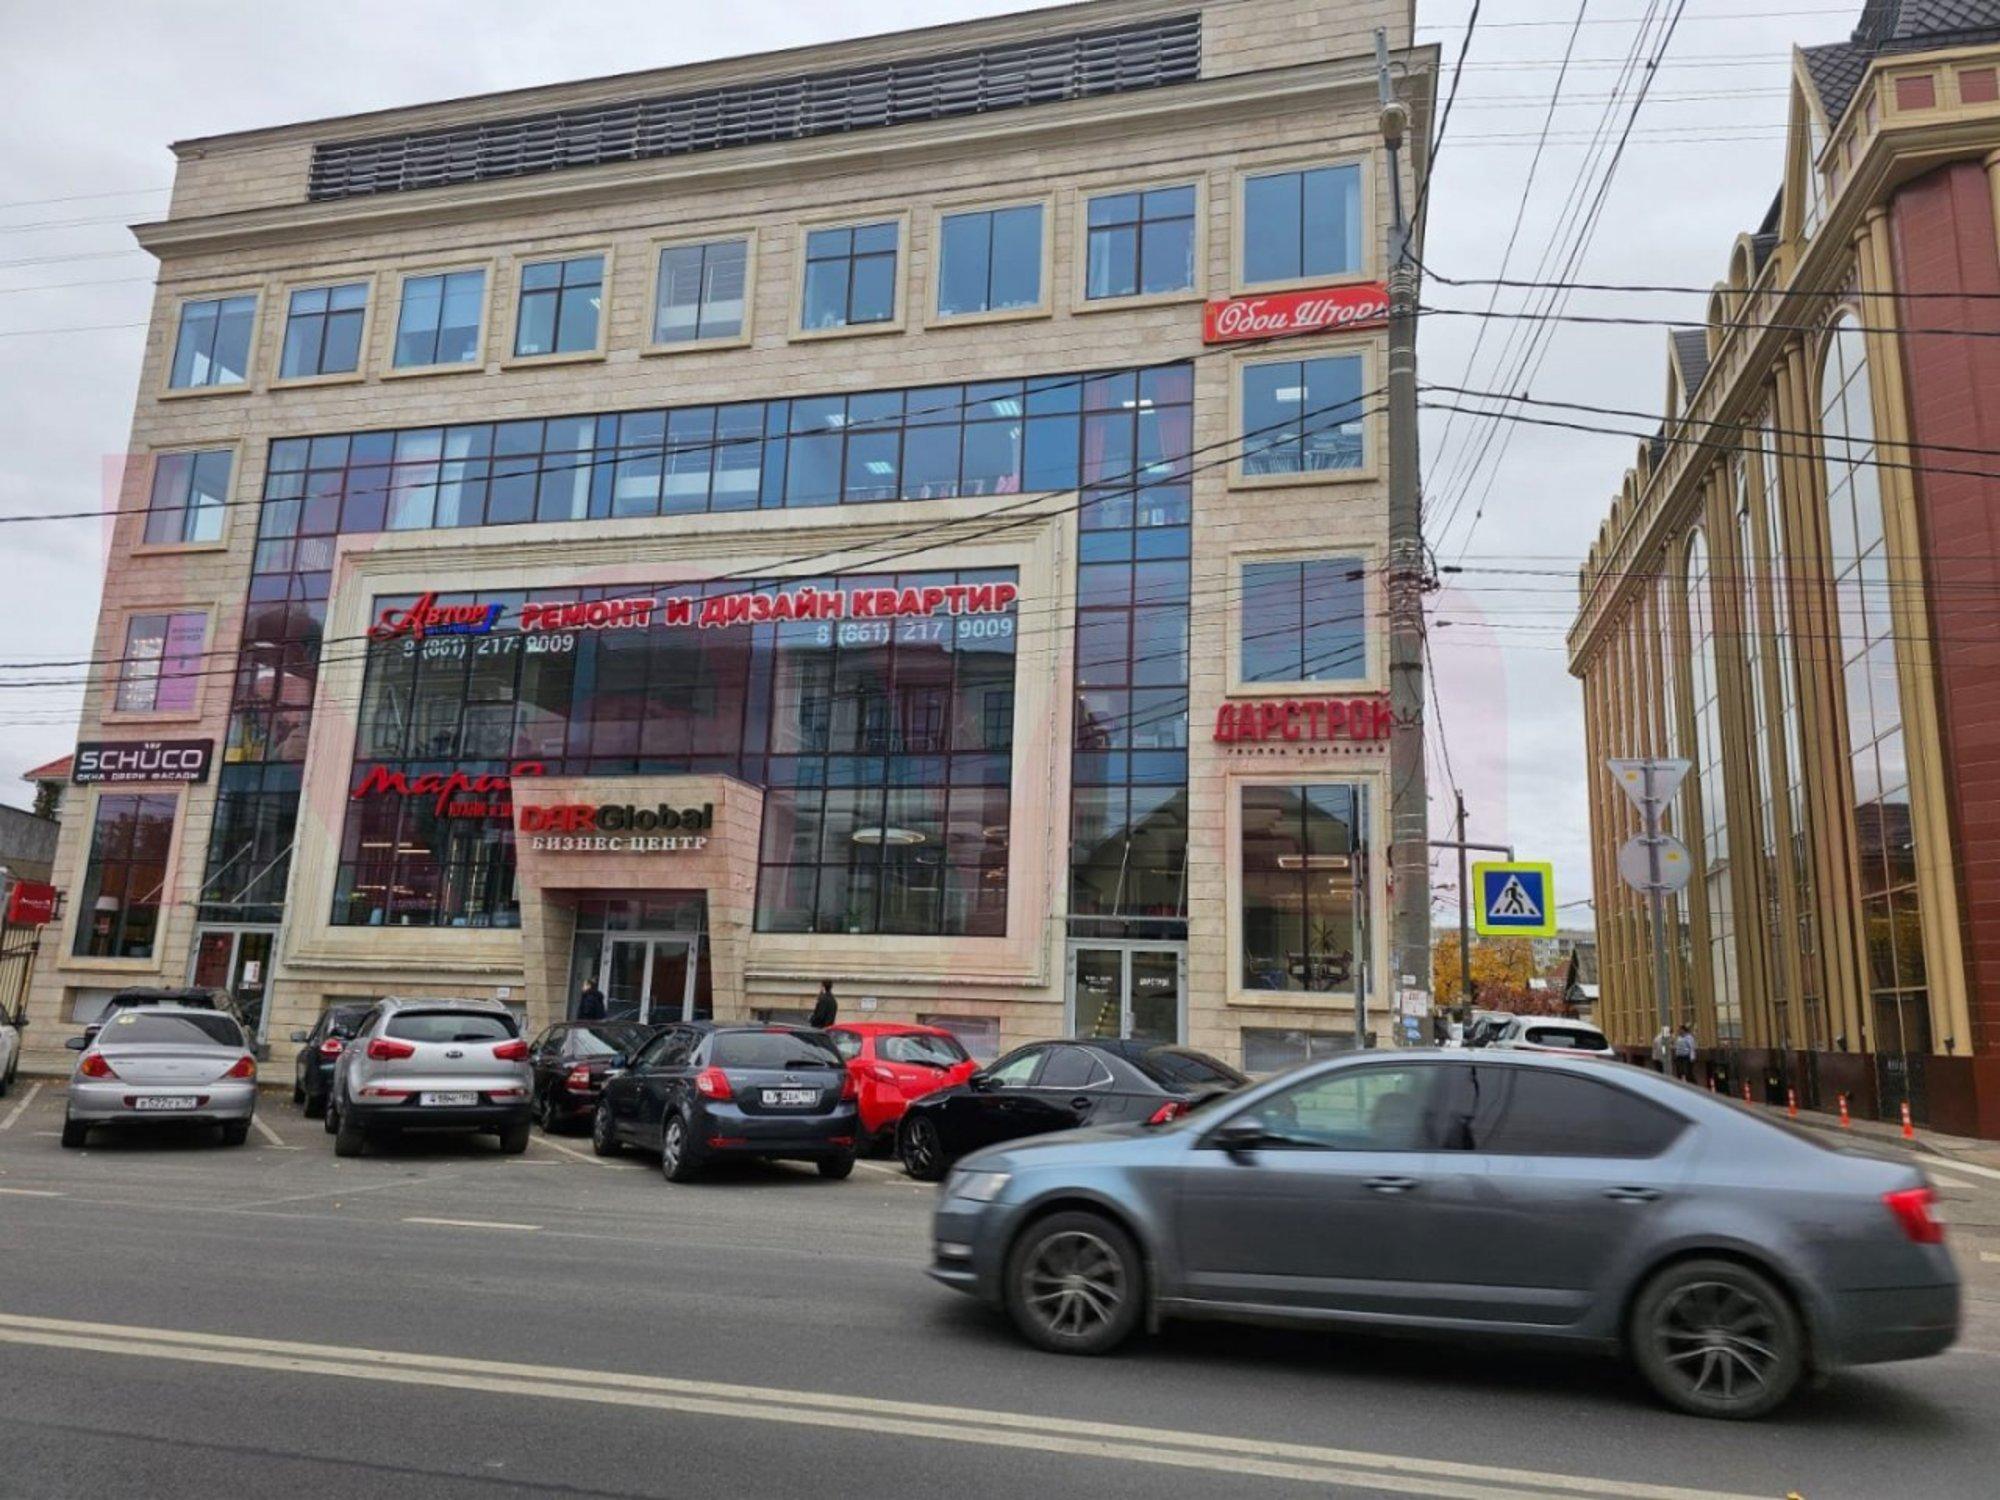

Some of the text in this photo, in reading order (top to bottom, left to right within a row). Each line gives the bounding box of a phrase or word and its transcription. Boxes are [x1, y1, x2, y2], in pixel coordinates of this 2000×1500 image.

[1216, 299, 1289, 335] Обои
[519, 581, 1018, 632] РЕМОНТ И ДИЗАЙН КВАРТИР
[816, 618, 1013, 646] 8 (861) 217 9009
[422, 638, 467, 661] (861)
[79, 747, 203, 770] SCHÜCO
[530, 835, 709, 854] БИЗНЕС ЦЕНТР
